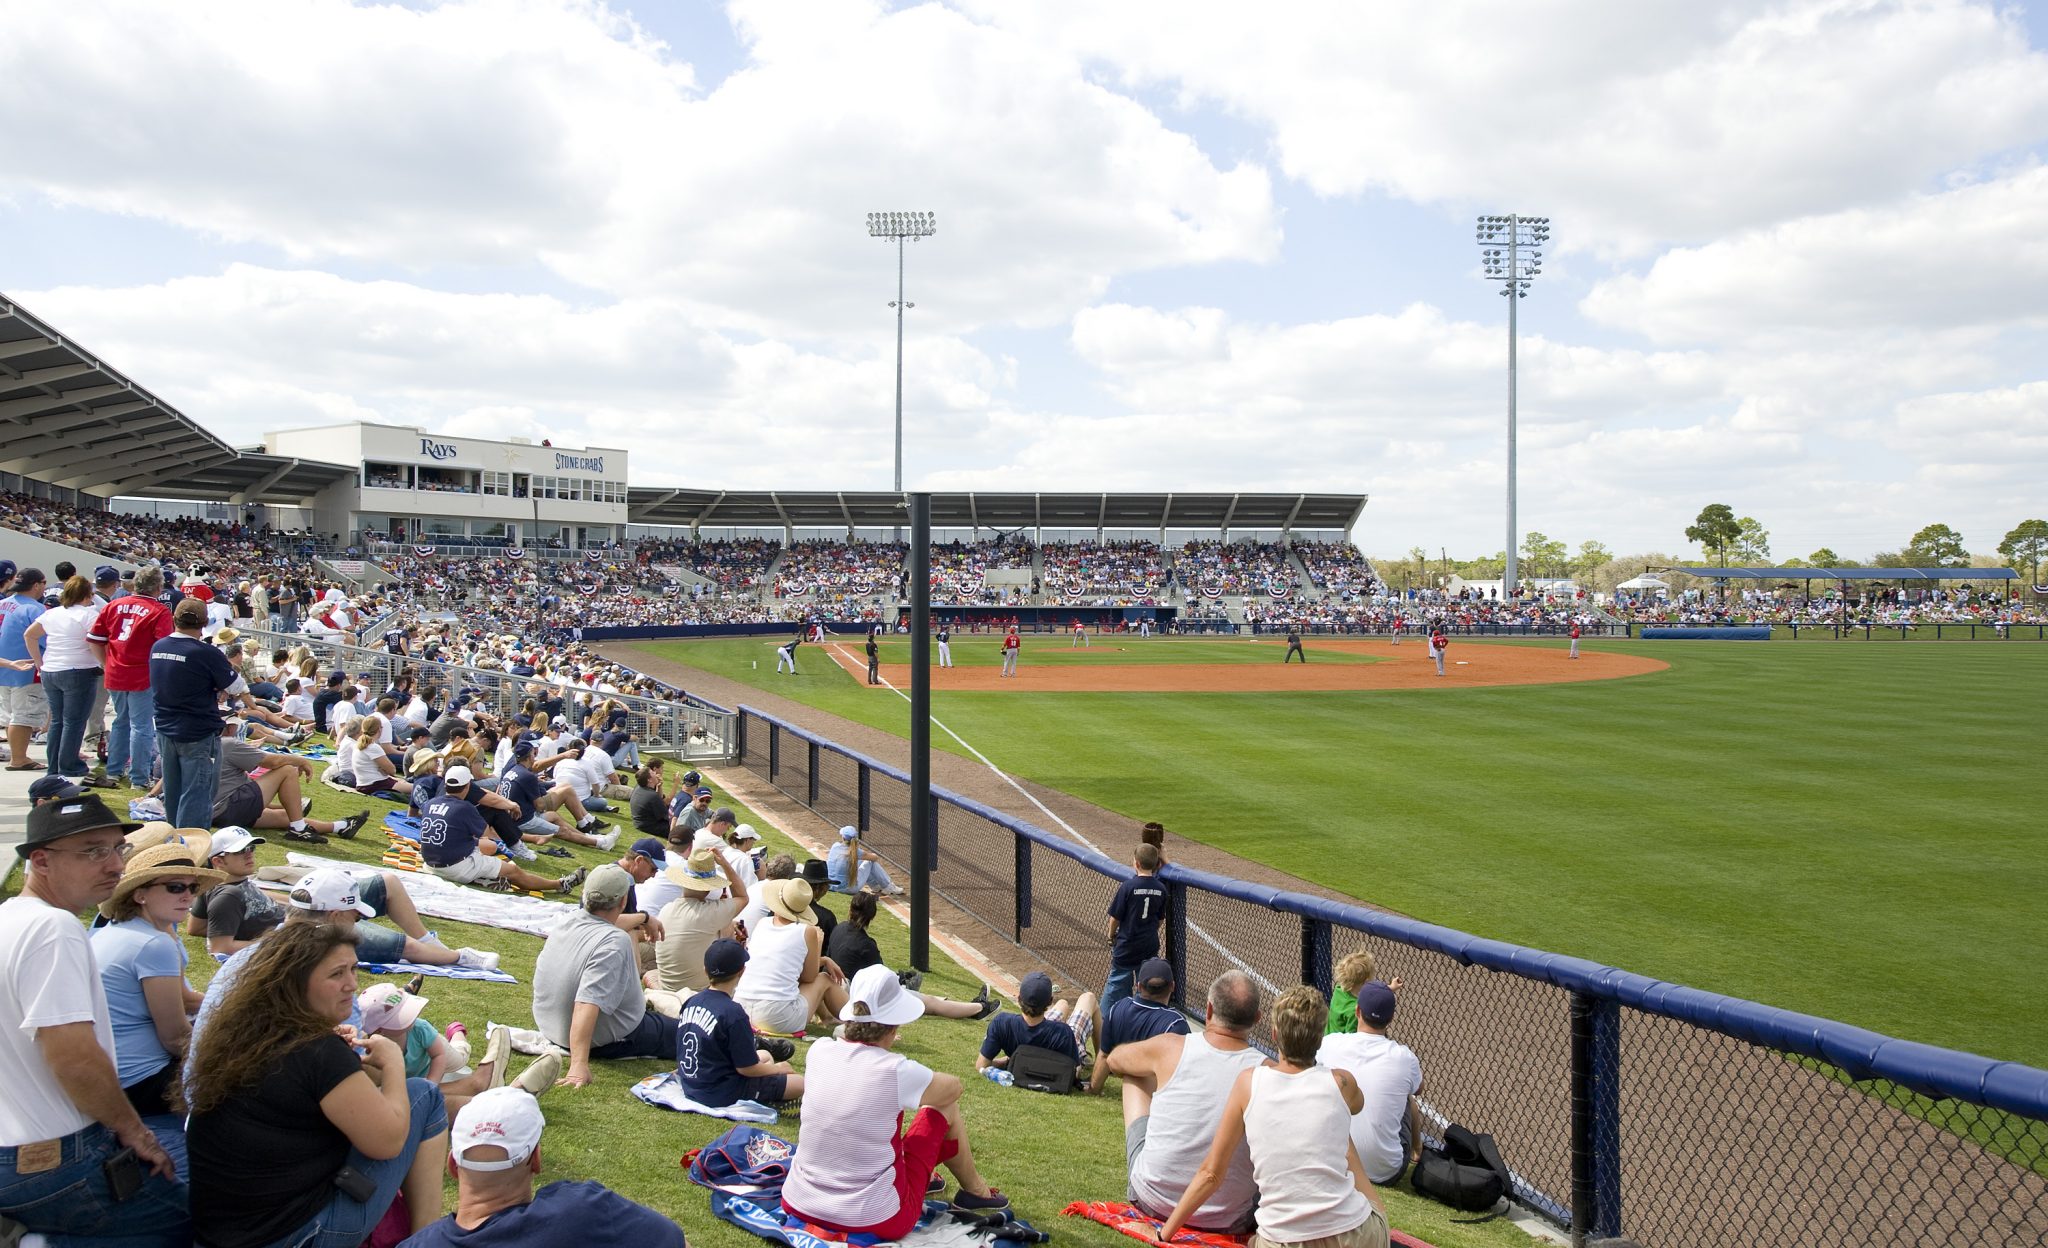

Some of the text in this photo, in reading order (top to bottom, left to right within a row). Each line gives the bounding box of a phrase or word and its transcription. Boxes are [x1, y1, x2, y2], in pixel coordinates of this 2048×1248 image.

[555, 452, 603, 473] STONE CRABS
[117, 604, 150, 617] PUJOLS
[117, 618, 135, 641] 5
[428, 802, 450, 817] PEÑA
[420, 817, 448, 845] 23
[1141, 897, 1150, 919] 1
[680, 1031, 699, 1076] 3
